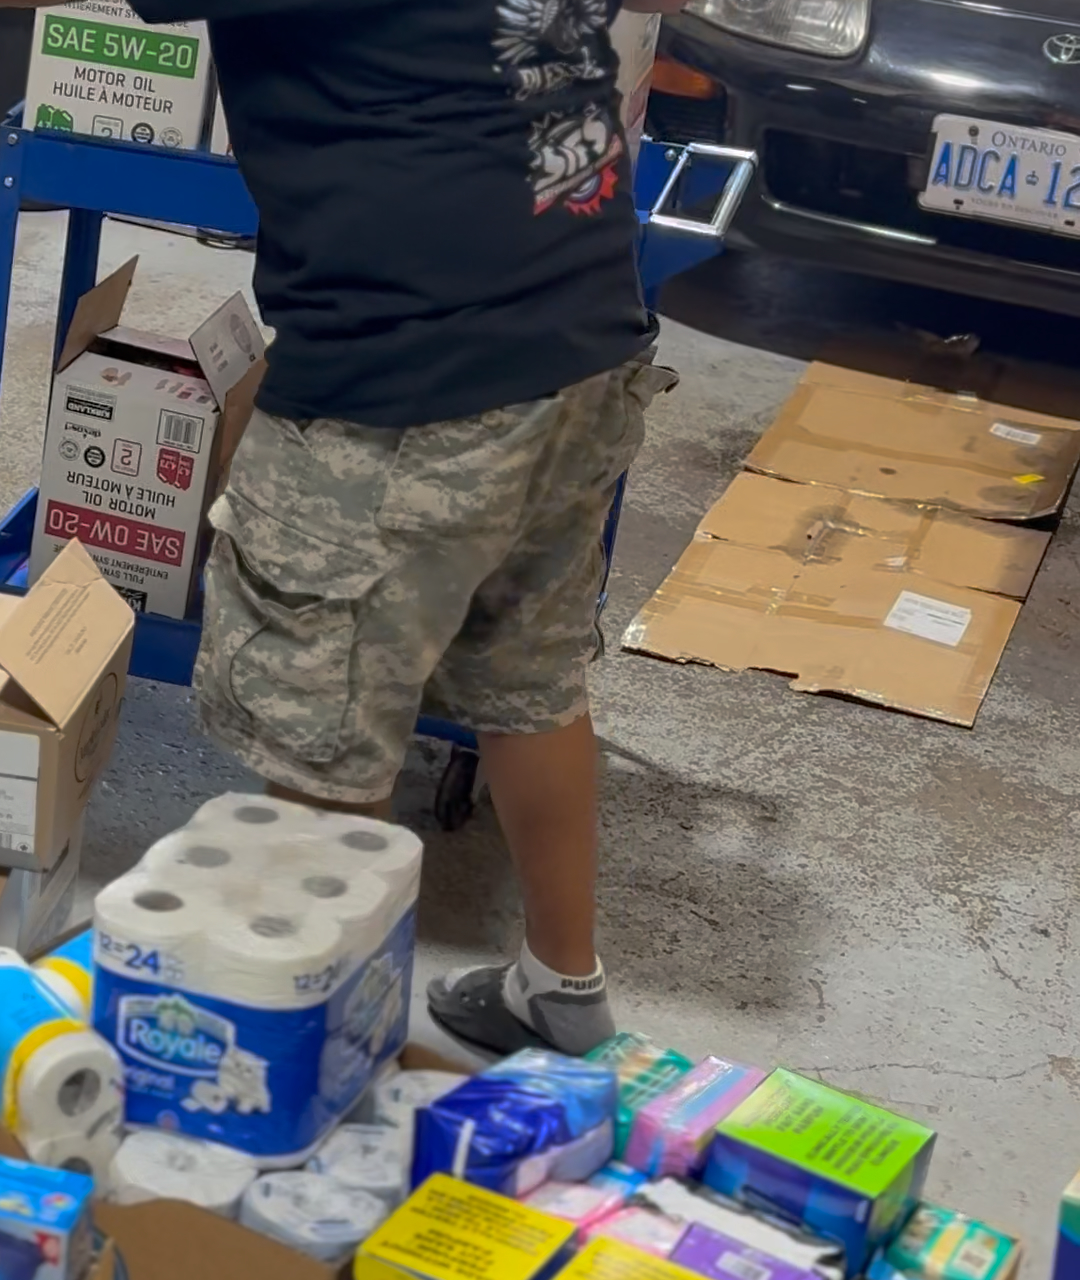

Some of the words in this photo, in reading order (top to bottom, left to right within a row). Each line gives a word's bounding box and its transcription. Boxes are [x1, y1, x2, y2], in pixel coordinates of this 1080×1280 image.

[46, 23, 97, 54] SAE
[103, 32, 193, 69] 5W-20
[73, 65, 126, 88] MOTOR
[133, 75, 156, 93] OIL
[52, 81, 96, 102] HUILE
[98, 86, 108, 104] À
[112, 92, 174, 115] MOTEUR
[991, 131, 1067, 157] ONTARIO
[932, 140, 1018, 200] ADCA
[67, 402, 114, 421] KIRKLAND
[66, 470, 121, 496] MOTEUR
[82, 490, 102, 506] OIL
[110, 497, 156, 520] MOTOR
[136, 489, 176, 508] HUILE
[136, 529, 181, 559] SAE
[123, 572, 144, 585] FULL
[129, 1018, 223, 1066] Royale
